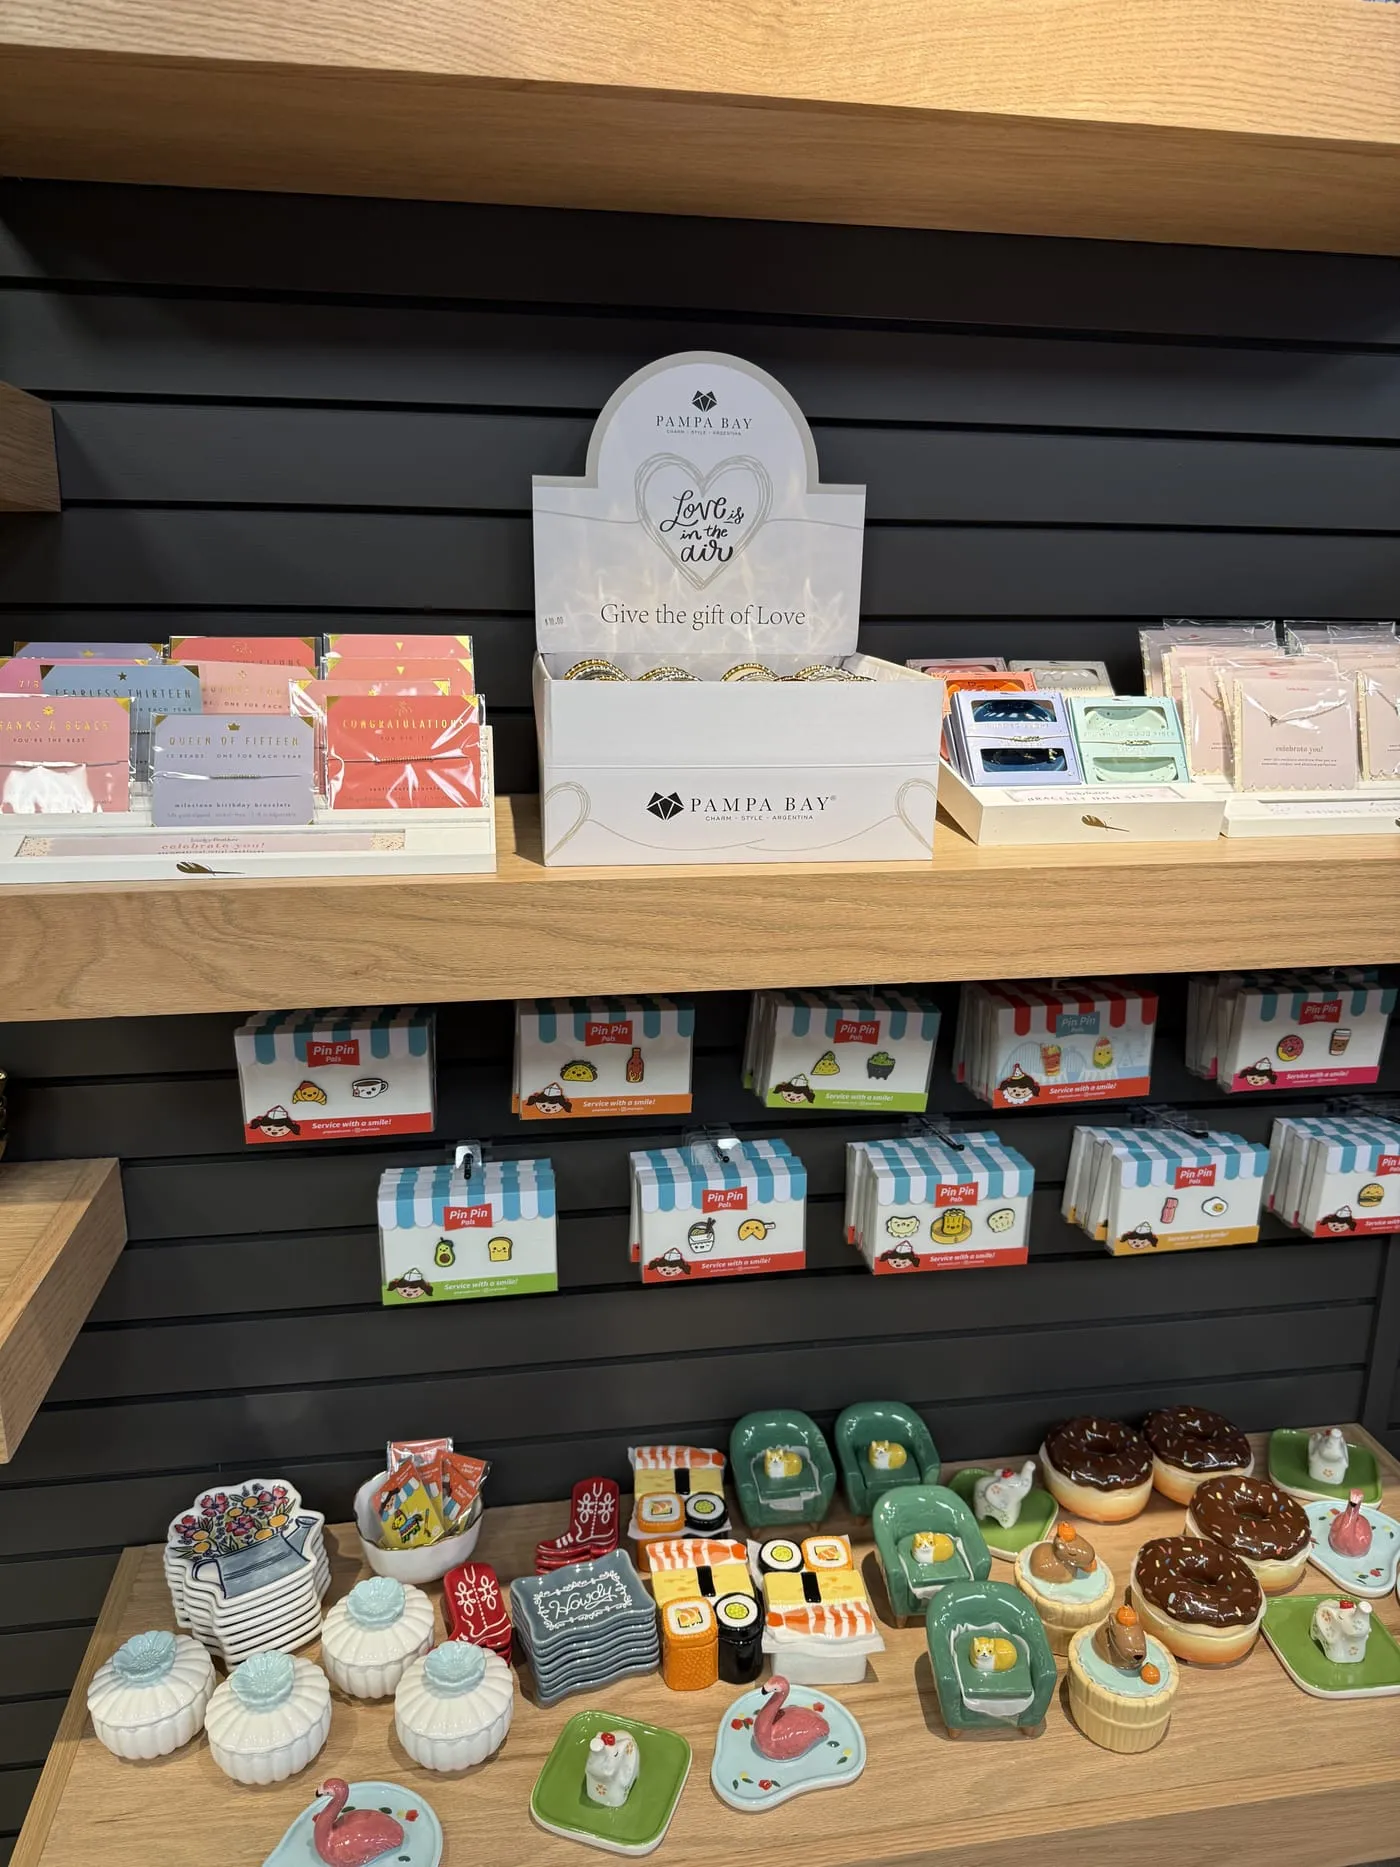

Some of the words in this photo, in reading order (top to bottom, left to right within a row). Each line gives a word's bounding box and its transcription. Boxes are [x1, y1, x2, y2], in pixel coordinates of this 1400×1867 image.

[656, 415, 713, 428] PAMPA
[721, 417, 752, 429] BAY
[659, 489, 727, 532] Love
[726, 506, 744, 524] is
[680, 530, 702, 540] in
[703, 524, 728, 539] the
[680, 539, 733, 562] air
[600, 603, 649, 624] Give
[655, 604, 687, 624] the
[692, 604, 725, 631] gift
[730, 604, 754, 625] of
[757, 605, 806, 625] Love
[128, 688, 191, 699] THIRTEEN
[169, 736, 211, 746] QUEEN
[221, 736, 234, 746] OF
[245, 736, 298, 746] FIFTEEN
[691, 797, 772, 812] PAMPA
[785, 796, 829, 812] BAY
[1304, 1005, 1320, 1014] Pin
[1322, 1004, 1338, 1013] Pin
[1062, 1017, 1077, 1027] Pin
[1080, 1016, 1096, 1025] Pin
[590, 1026, 608, 1036] Pin
[611, 1025, 628, 1034] Pin
[840, 1024, 856, 1033] Pin
[859, 1024, 876, 1034] Pin
[313, 1045, 332, 1055] Pin
[335, 1044, 355, 1055] Pin
[1049, 1087, 1075, 1095] Service
[1382, 1157, 1397, 1167] Pin
[1180, 1169, 1196, 1179] Pin
[1197, 1168, 1213, 1177] Pin
[707, 1192, 724, 1202] Pin
[726, 1191, 744, 1201] Pin
[940, 1187, 957, 1197] Pin
[958, 1186, 975, 1196] Pin
[449, 1210, 467, 1220] Pin
[470, 1208, 488, 1218] Pin
[496, 1278, 519, 1286] smile!
[549, 1583, 618, 1620] Howdy
